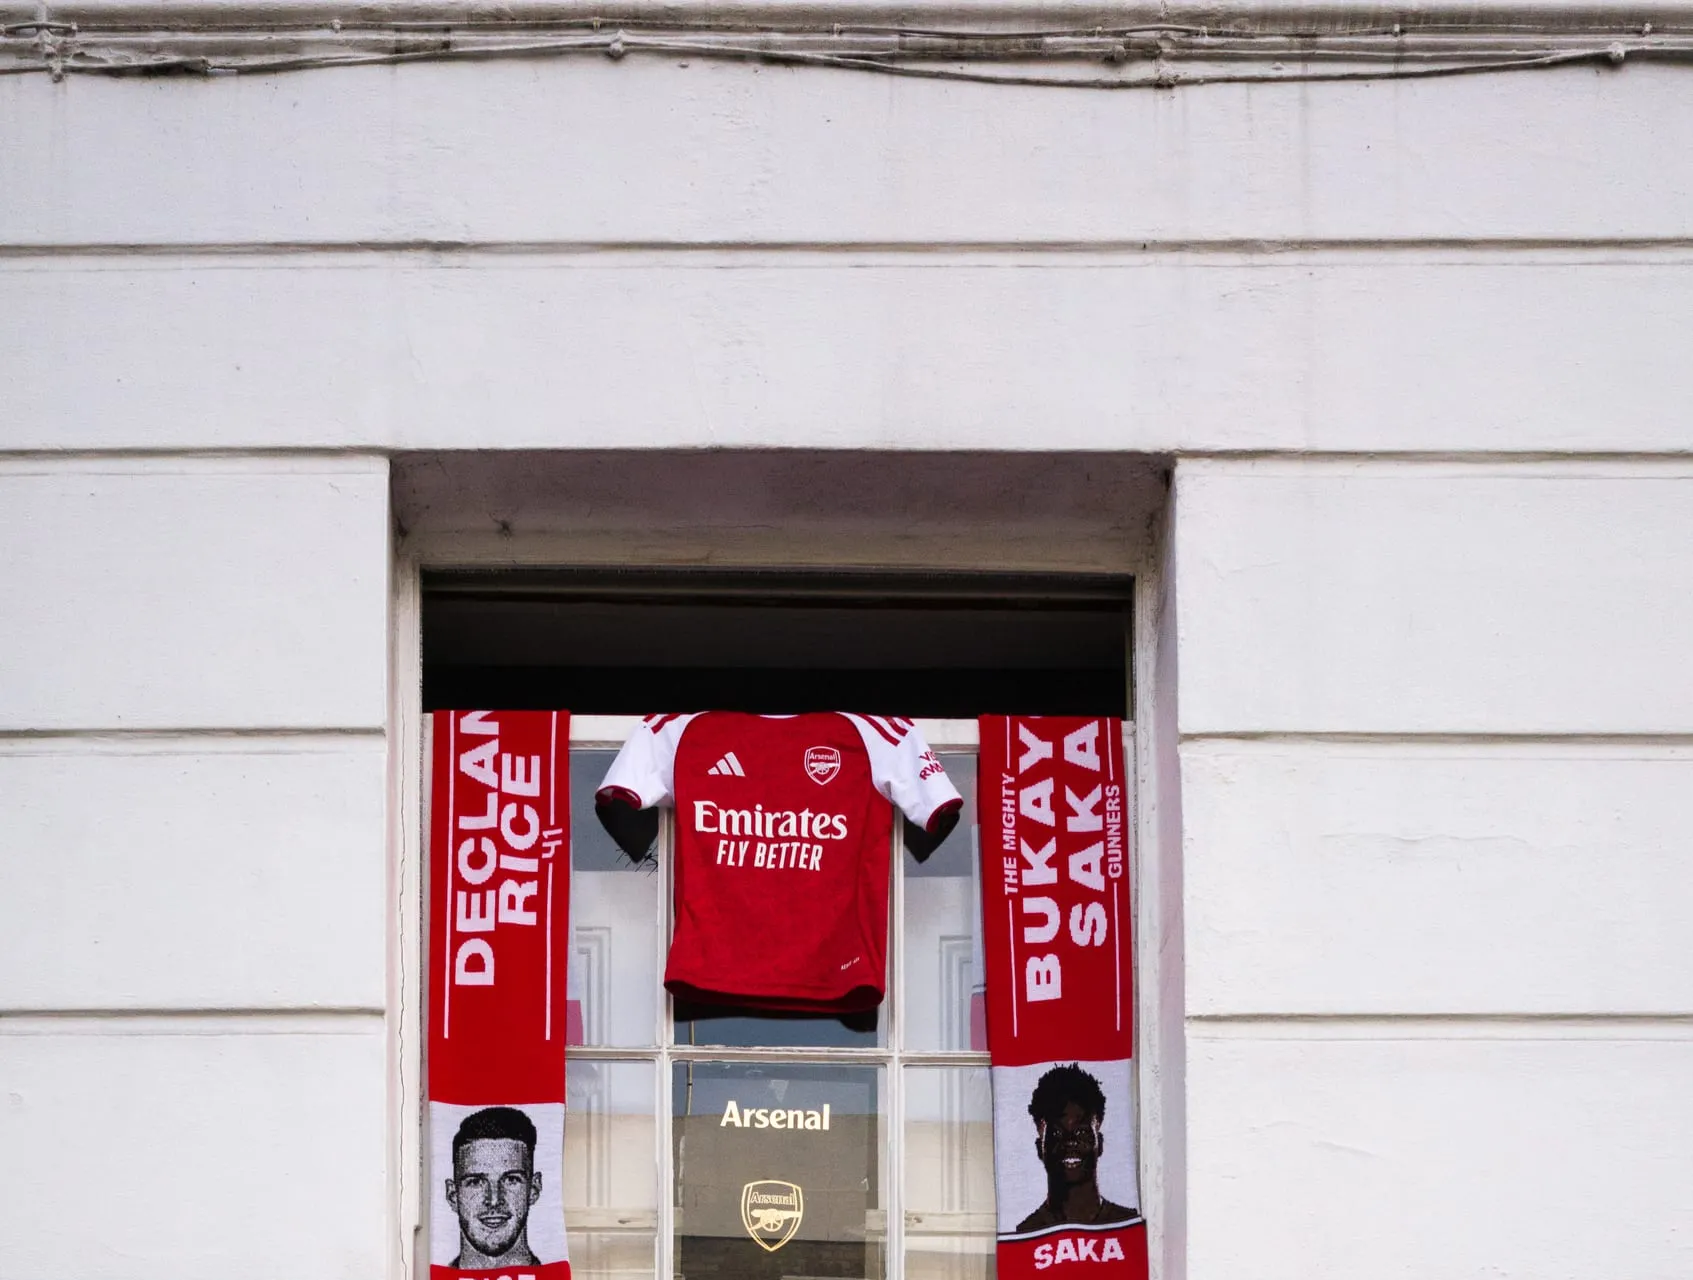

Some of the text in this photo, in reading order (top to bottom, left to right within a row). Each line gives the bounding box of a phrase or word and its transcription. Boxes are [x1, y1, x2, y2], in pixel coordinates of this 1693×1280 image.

[809, 752, 836, 761] Arsenal
[694, 800, 848, 840] Emirates
[1002, 773, 1018, 895] THE MIGHTY
[1063, 720, 1108, 948] SAKA
[1105, 784, 1123, 879] GUNNERS
[498, 753, 540, 926] RICE
[541, 828, 563, 859] 41
[716, 840, 823, 871] FLY BETTER
[1018, 716, 1062, 1003] BUKAY
[719, 1100, 831, 1131] Arsenal
[750, 1192, 795, 1205] Arsenal
[1033, 1235, 1125, 1271] SAKA
